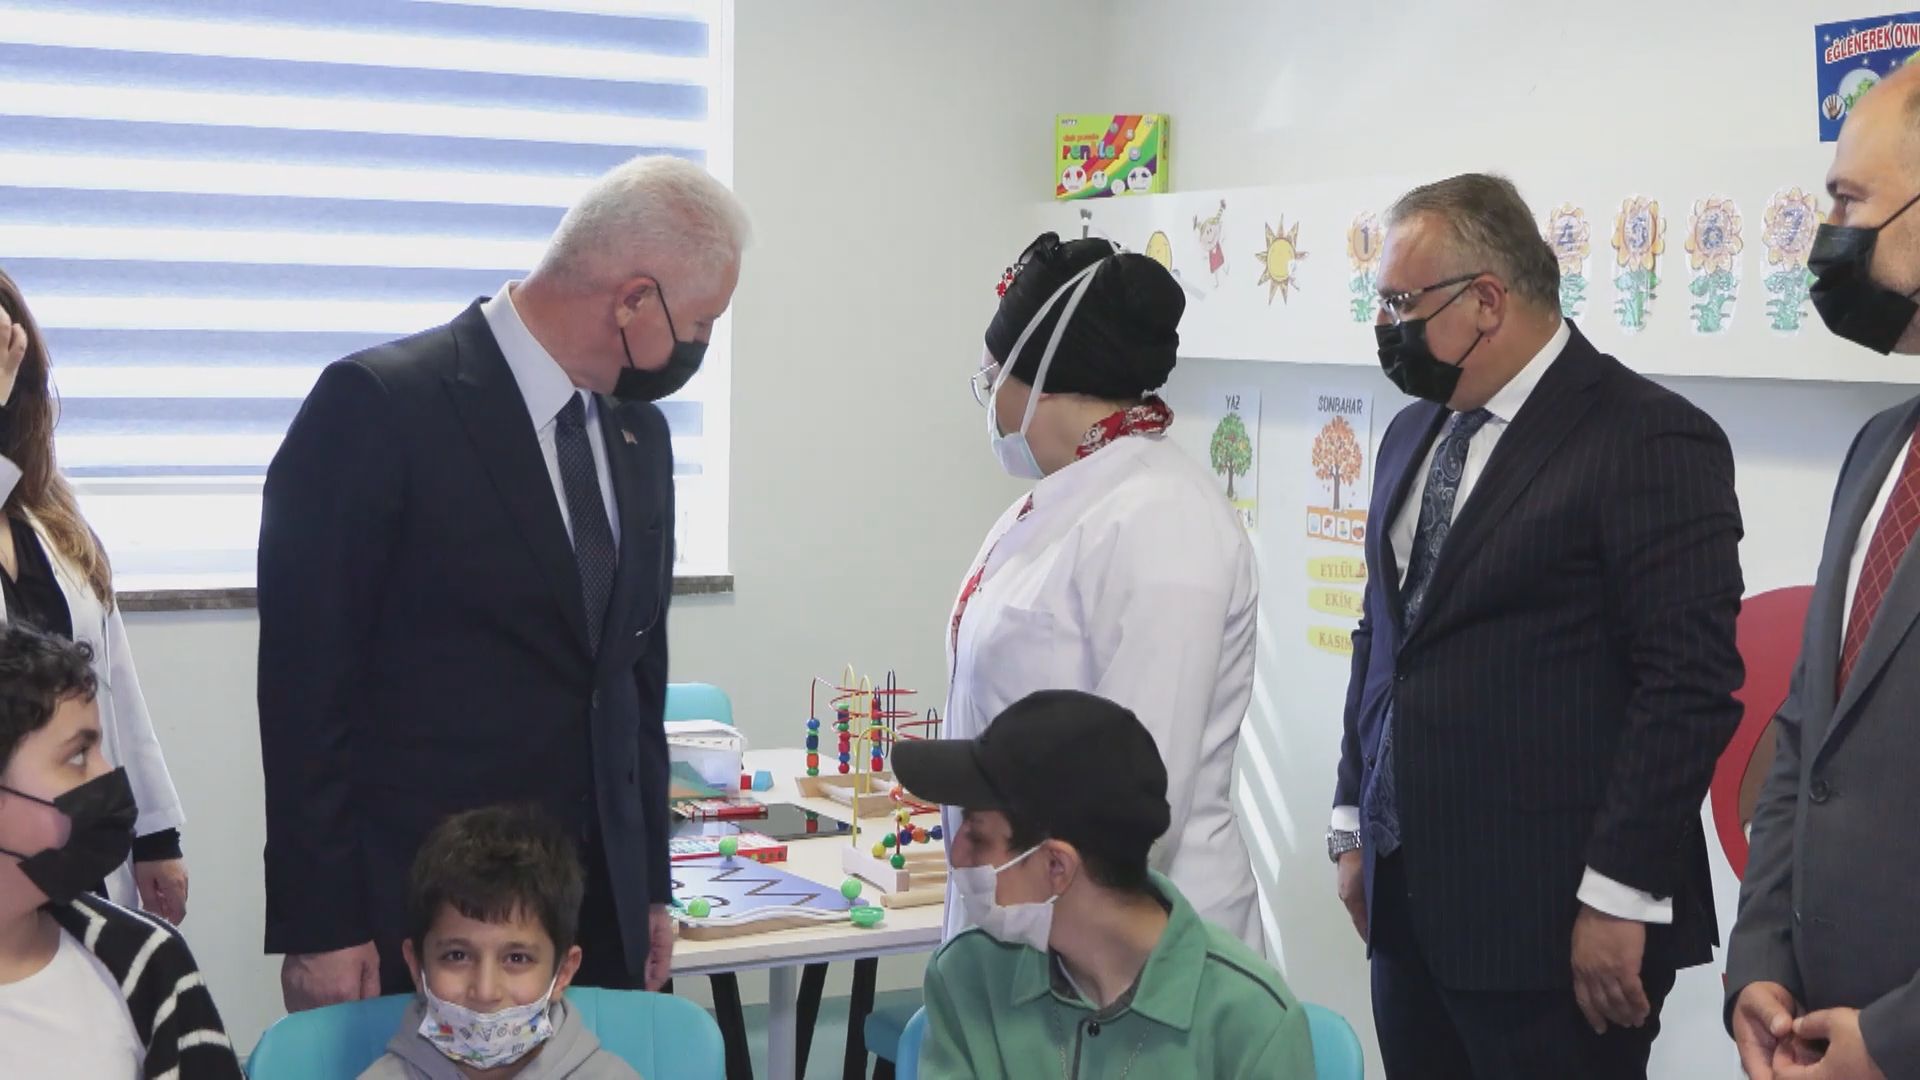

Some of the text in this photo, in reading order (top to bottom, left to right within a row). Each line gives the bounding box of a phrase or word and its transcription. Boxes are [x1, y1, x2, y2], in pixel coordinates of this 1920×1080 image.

[1825, 23, 1920, 63] EĞLENEREK OYN
[1225, 395, 1241, 411] YAZ
[1317, 395, 1363, 415] SONBAHAR
[1320, 561, 1354, 578] EYLÜL
